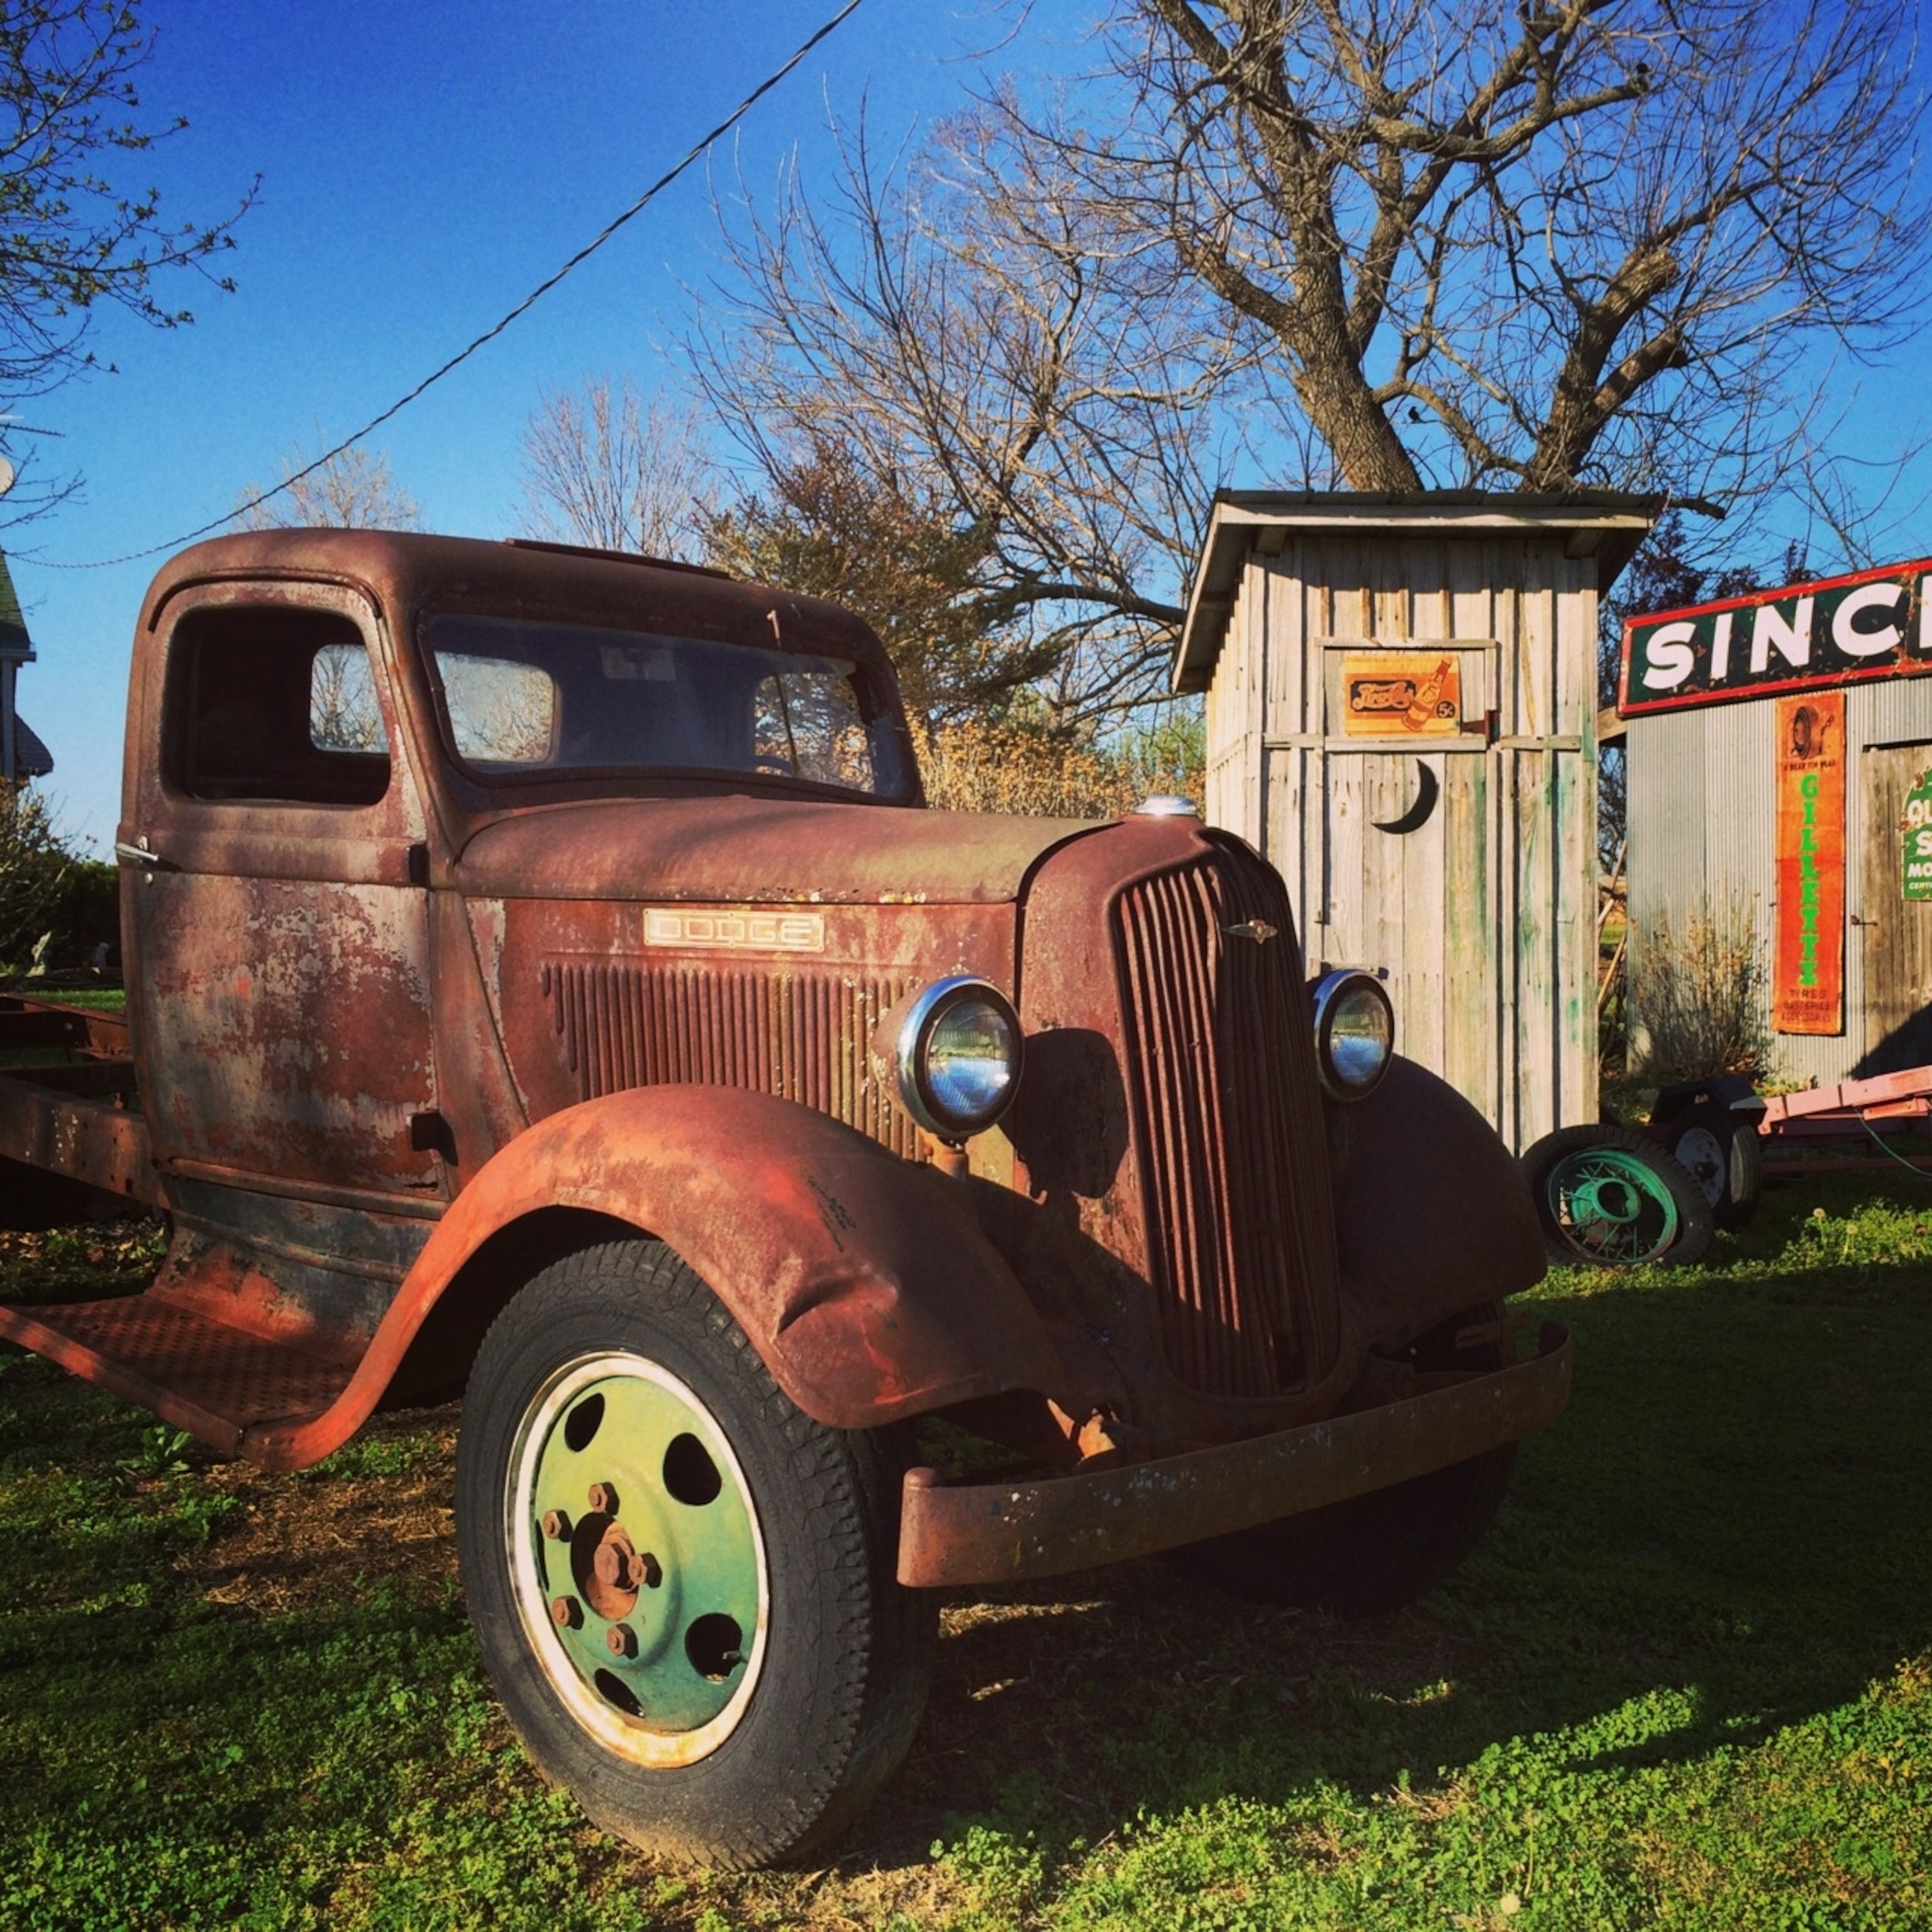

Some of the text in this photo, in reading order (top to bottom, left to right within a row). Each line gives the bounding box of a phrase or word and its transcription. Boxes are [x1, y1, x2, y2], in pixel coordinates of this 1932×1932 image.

[1642, 575, 1932, 690] SINC
[1800, 774, 1819, 985] GILLETTE
[652, 917, 813, 945] DODGE
[1789, 989, 1826, 999] TIRES
